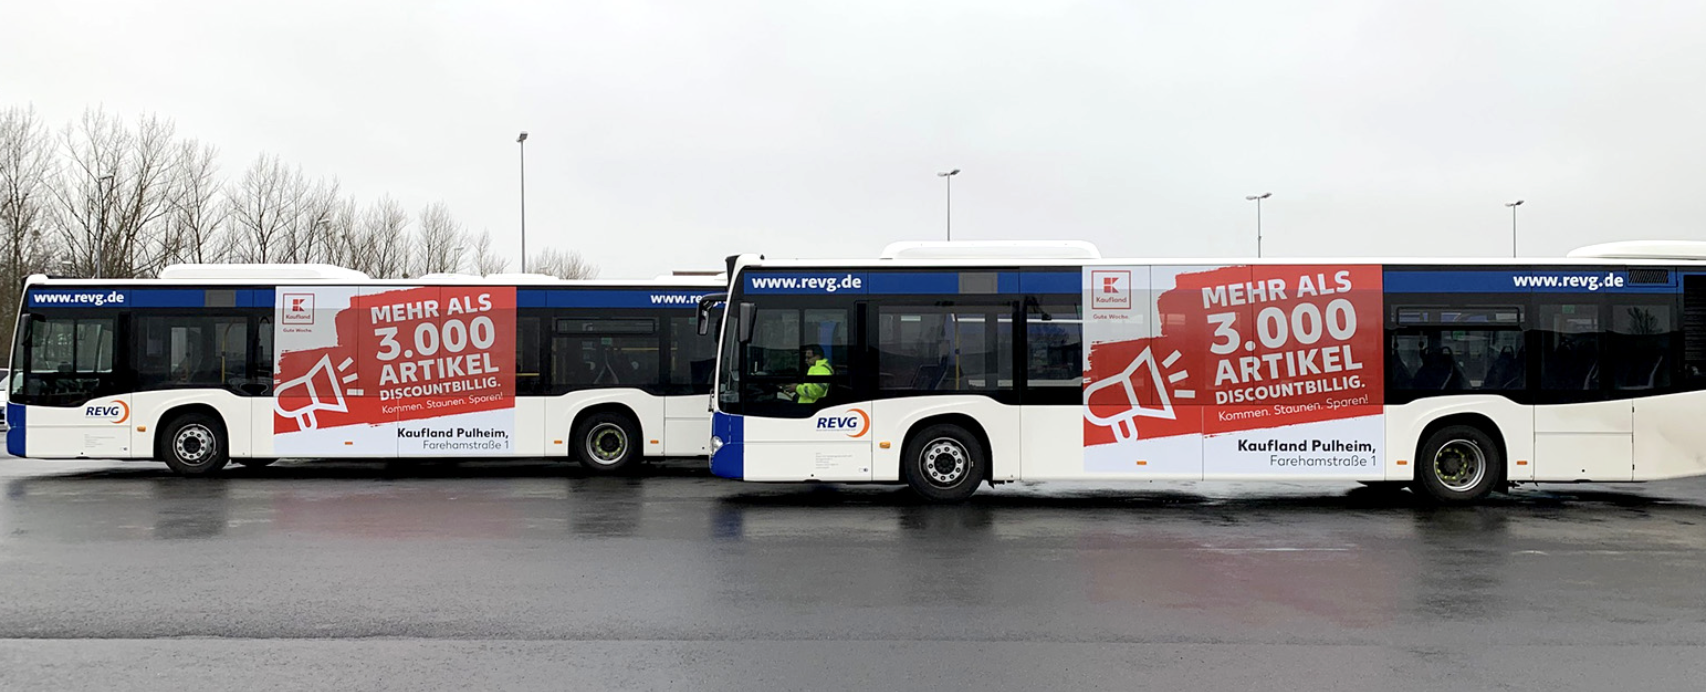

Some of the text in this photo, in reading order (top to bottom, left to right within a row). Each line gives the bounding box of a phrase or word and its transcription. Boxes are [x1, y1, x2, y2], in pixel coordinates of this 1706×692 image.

[751, 274, 862, 292] www.revg.de
[1202, 270, 1352, 309] MEHR ALS
[1513, 272, 1624, 291] www.revg.de
[33, 291, 125, 306] www.revg.de
[370, 293, 492, 325] MEHR ALS
[1206, 298, 1357, 355] 3.000
[374, 316, 495, 361] 3.000
[379, 352, 499, 386] ARTIKEL
[1214, 344, 1363, 386] ARTIKEL
[379, 376, 501, 401] DISCOUNTBILLIG.
[1215, 375, 1365, 405] DISCOUNTBILLIG.
[85, 406, 119, 416] REVG
[382, 392, 504, 414] Kommen. Staunen. Sparen!
[1218, 394, 1369, 422] Kommen. Staunen. Sparen!
[816, 417, 858, 428] REVG
[397, 428, 509, 440] Kaufland Pulheim,
[423, 440, 509, 450] Farehamstraße 1
[1238, 439, 1377, 454] Kaufland Pulheim,
[1270, 455, 1377, 466] Farehamstraße 1
